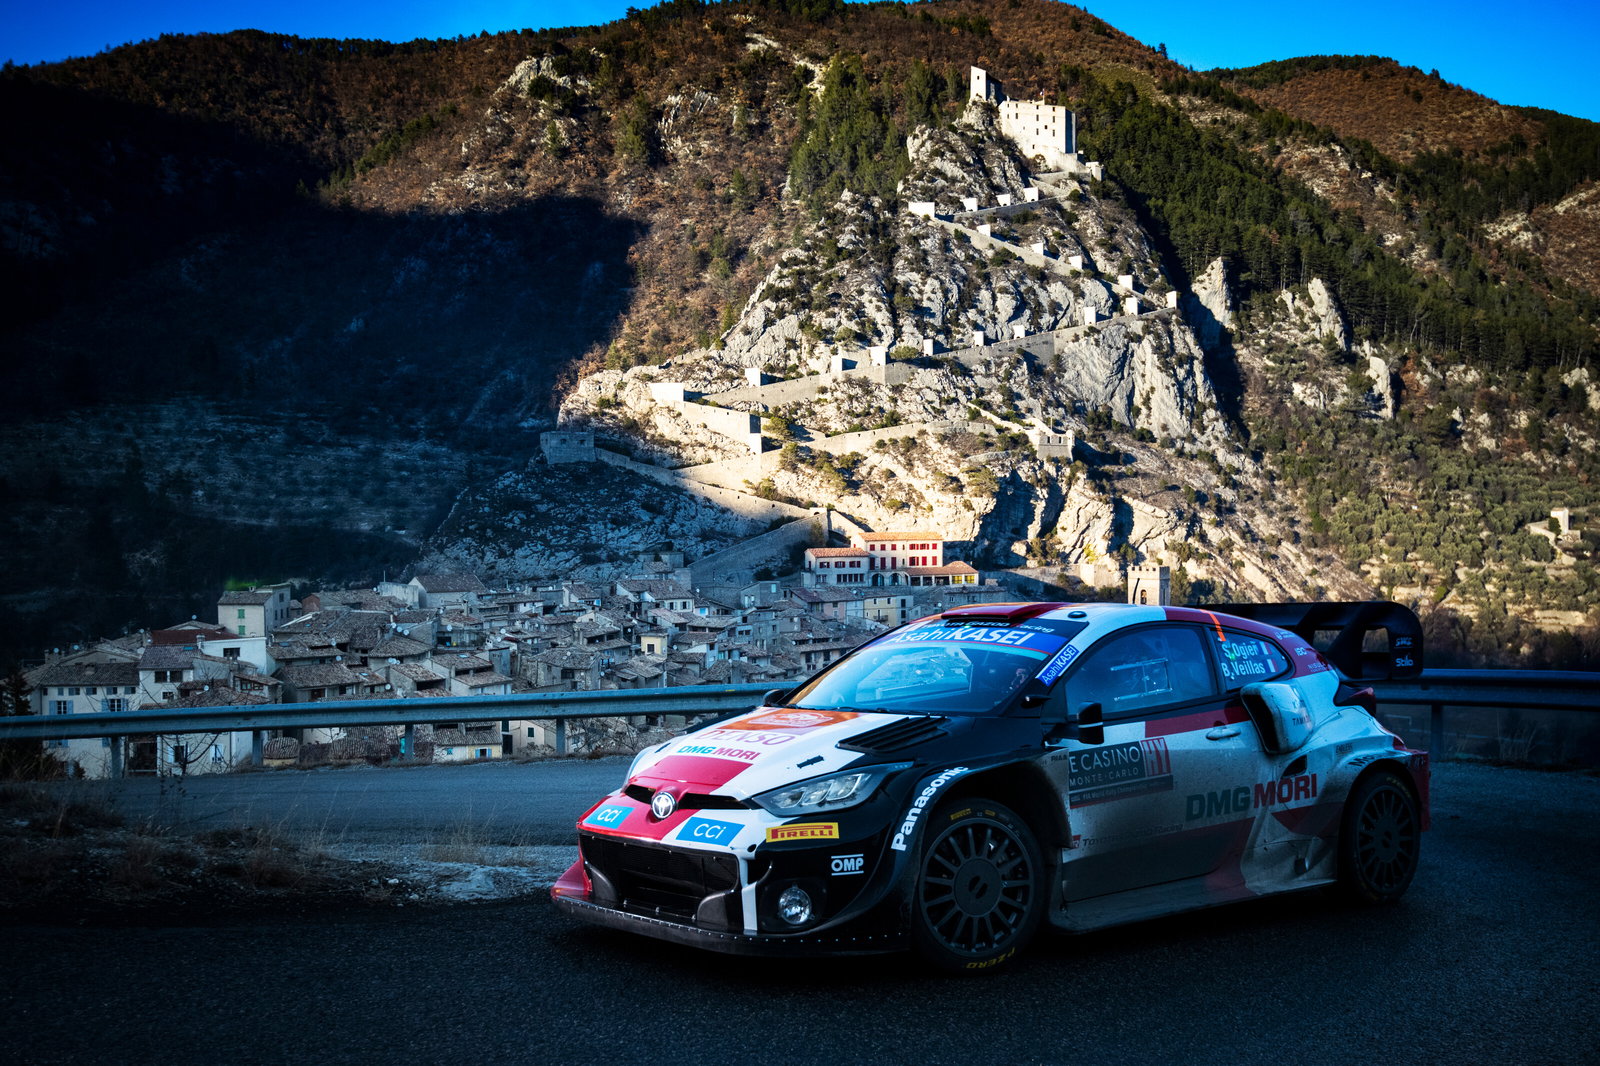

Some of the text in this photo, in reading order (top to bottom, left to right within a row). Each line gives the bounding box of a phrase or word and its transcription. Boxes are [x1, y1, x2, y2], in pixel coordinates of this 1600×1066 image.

[695, 730, 796, 746] DENSO
[677, 745, 761, 761] DMG MORI
[1080, 745, 1141, 772] CASINO
[1186, 773, 1318, 822] DMG MORI
[890, 766, 969, 851] Panasonic
[771, 825, 834, 840] PIRELLI
[831, 856, 864, 872] OMP
